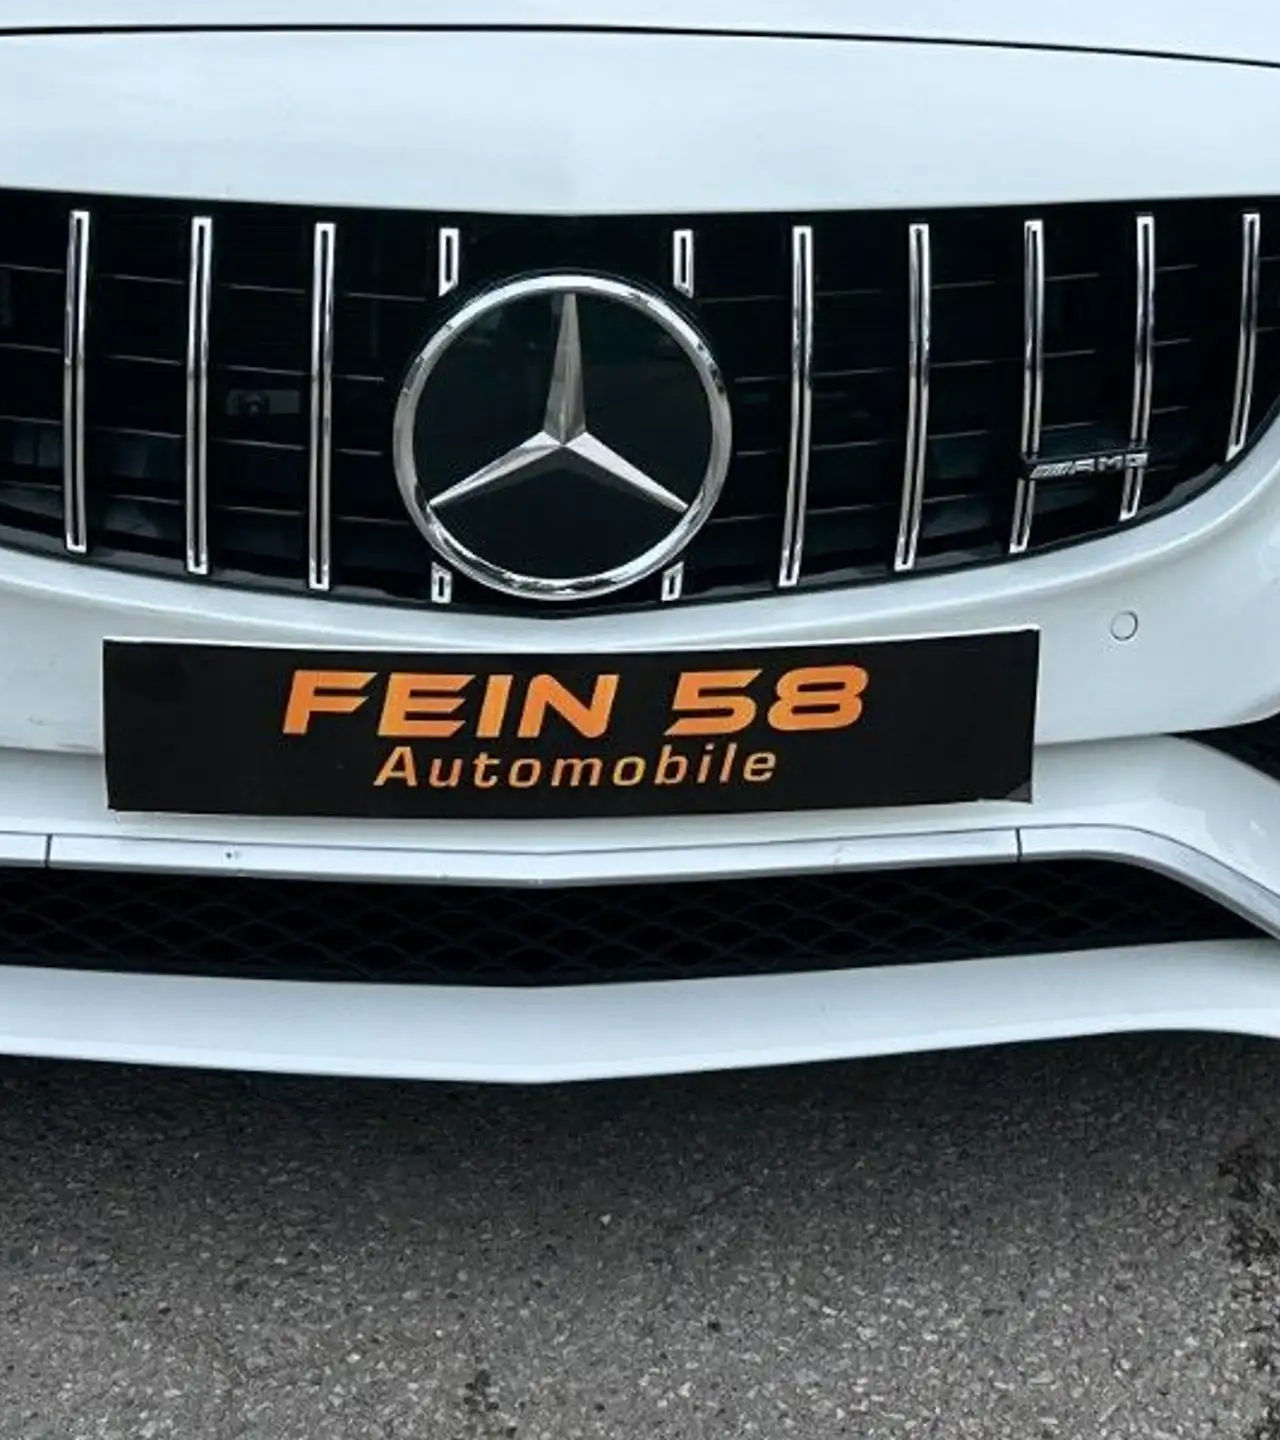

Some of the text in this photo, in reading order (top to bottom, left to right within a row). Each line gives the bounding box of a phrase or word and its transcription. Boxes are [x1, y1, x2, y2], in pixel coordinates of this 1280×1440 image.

[282, 664, 870, 739] FEIN 58
[372, 742, 778, 789] Automobile
